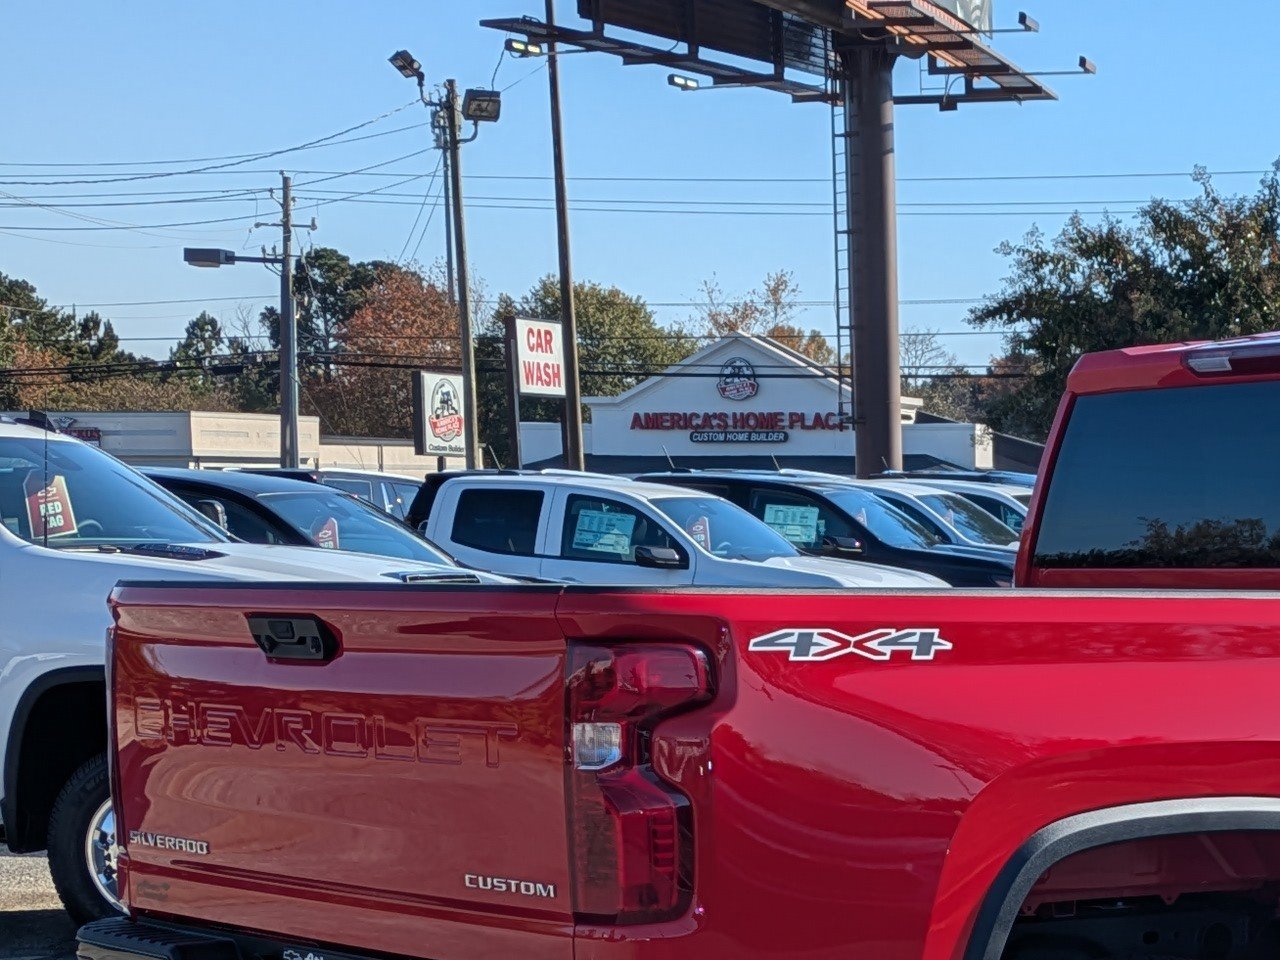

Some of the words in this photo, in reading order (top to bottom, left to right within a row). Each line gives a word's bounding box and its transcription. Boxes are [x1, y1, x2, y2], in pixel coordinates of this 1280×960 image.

[527, 327, 553, 354] CAR
[523, 360, 562, 388] WASH
[630, 411, 729, 430] AMERICA'S
[732, 411, 785, 430] HOME
[692, 431, 725, 441] CUSTOM
[726, 432, 749, 441] HOME
[750, 432, 784, 441] BUILDER
[134, 696, 519, 769] CHEVROLET
[129, 830, 209, 855] SILVERADO
[464, 874, 555, 898] CUSTOM
